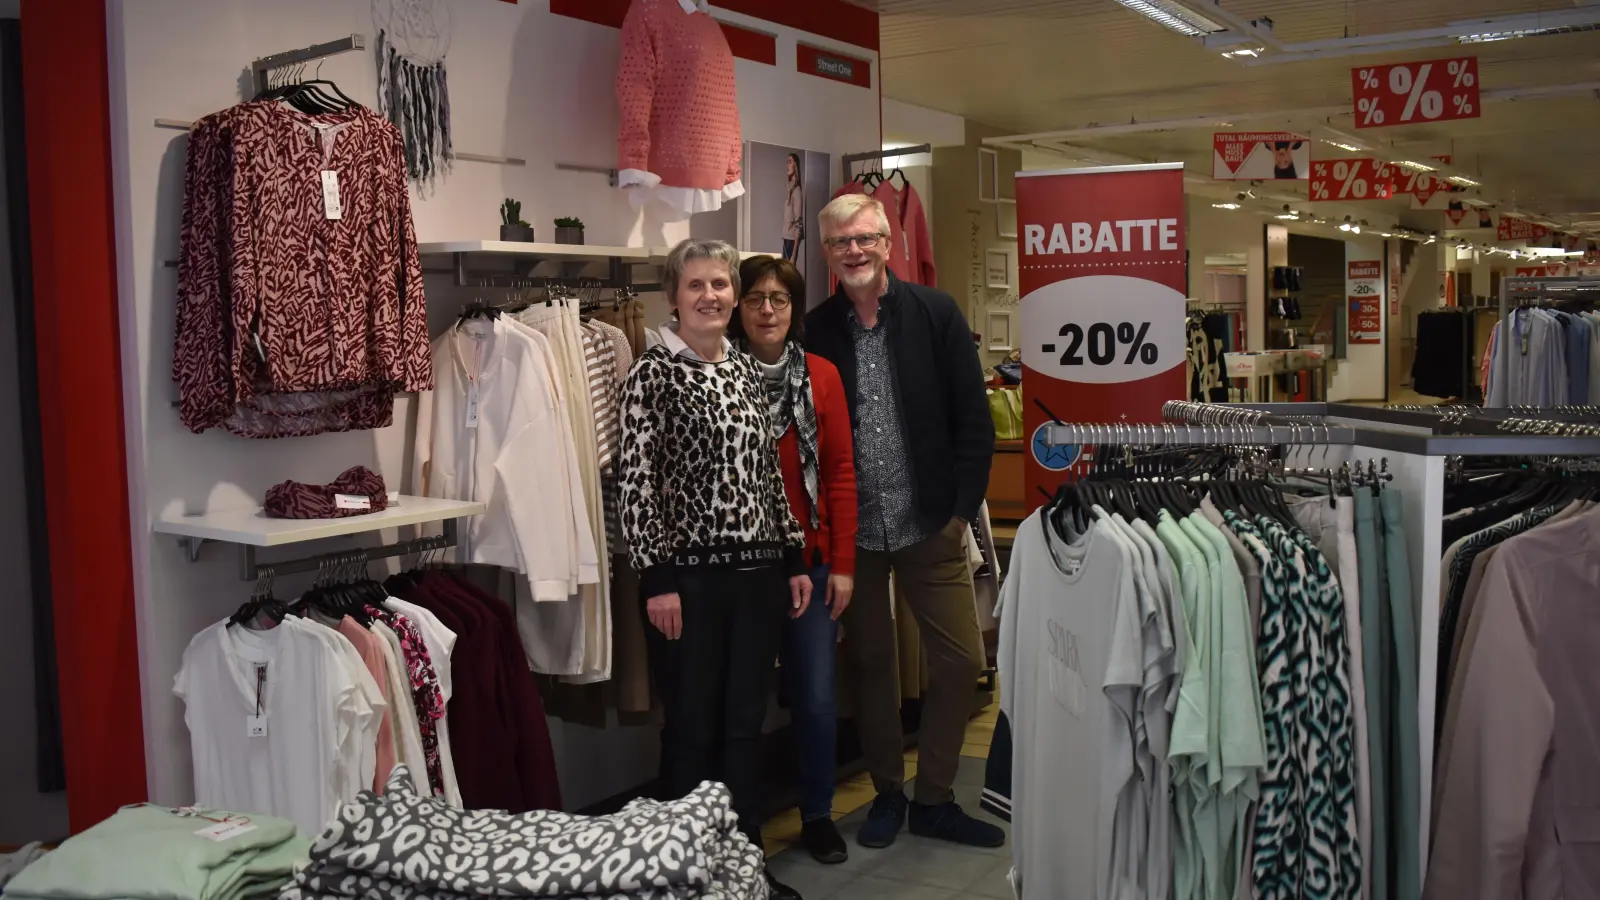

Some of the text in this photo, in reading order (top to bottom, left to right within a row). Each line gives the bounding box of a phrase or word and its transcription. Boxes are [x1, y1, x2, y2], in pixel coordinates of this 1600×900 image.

[817, 58, 852, 76] Street One
[1388, 63, 1444, 122] %
[1215, 134, 1236, 142] TOTAL
[1024, 217, 1178, 256] RABATTE
[1041, 321, 1159, 367] -20%
[708, 552, 733, 565] AT
